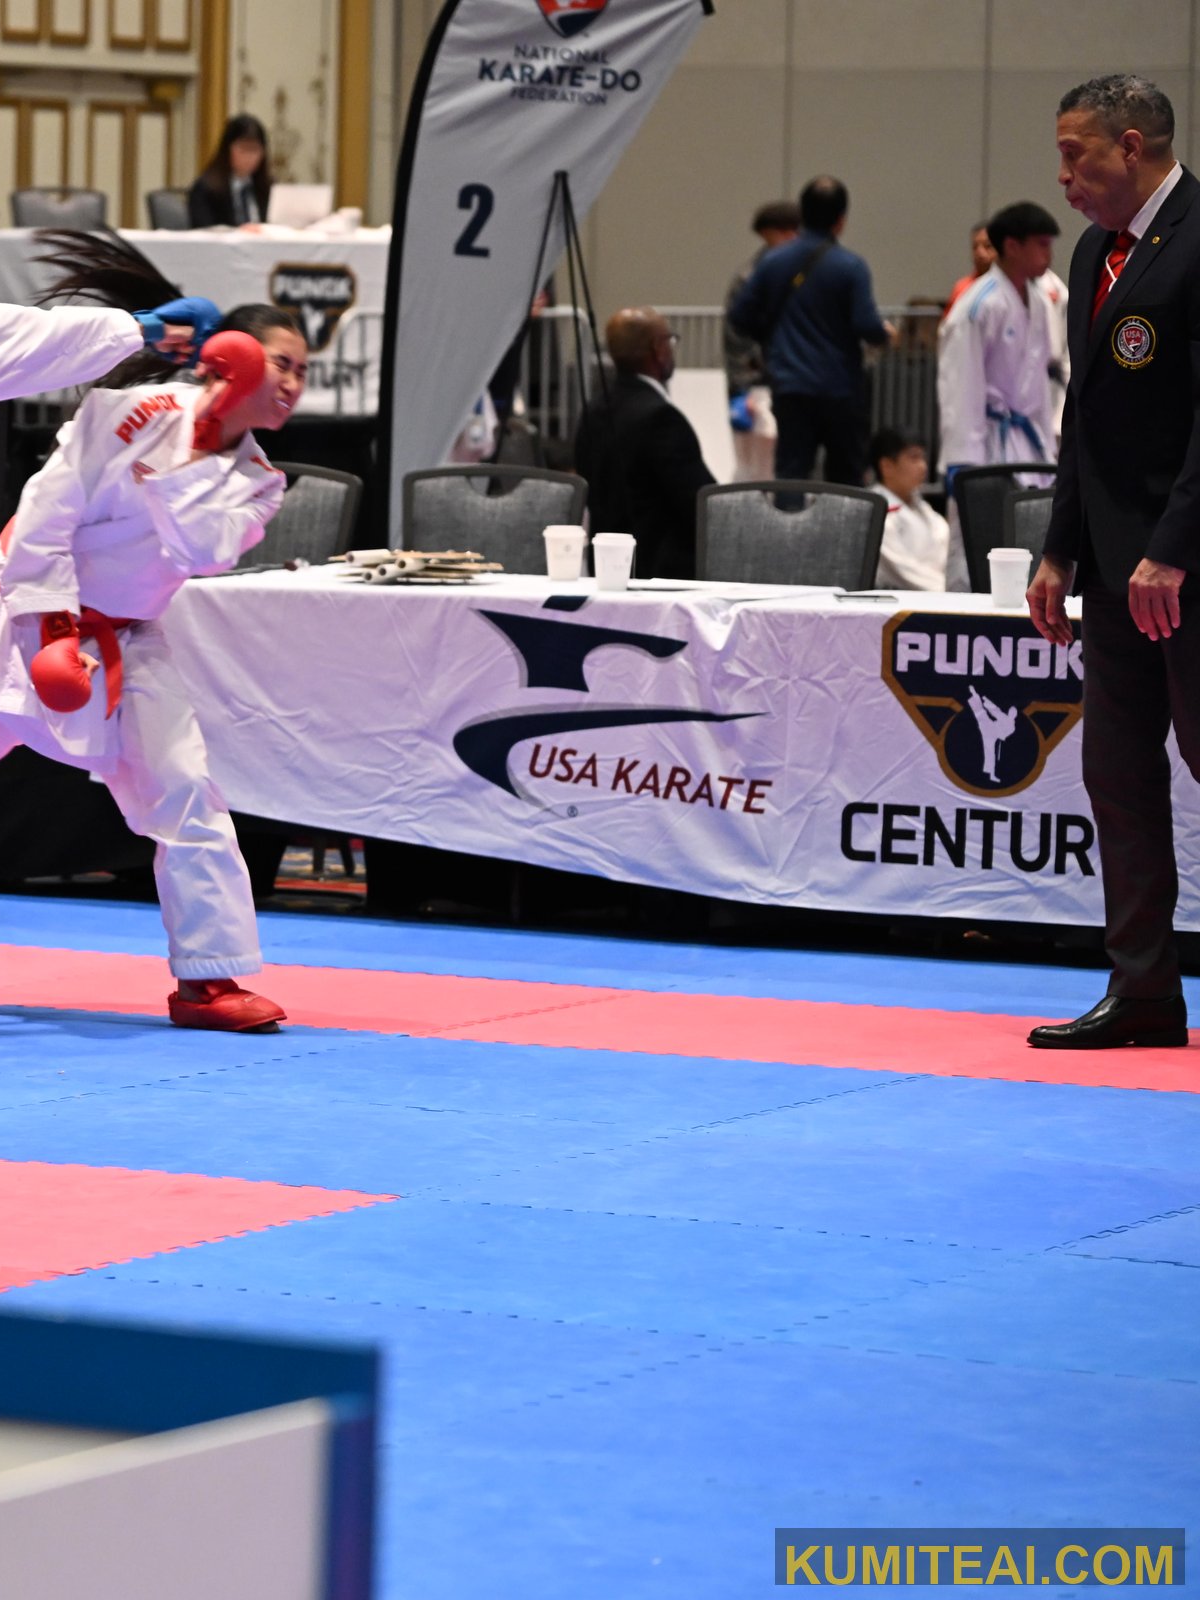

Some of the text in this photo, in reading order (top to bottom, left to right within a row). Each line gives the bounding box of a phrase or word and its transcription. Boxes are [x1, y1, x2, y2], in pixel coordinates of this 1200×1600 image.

[478, 58, 641, 92] KARATE-DO
[514, 45, 609, 64] NATIONAL
[510, 86, 608, 105] FEDERATION
[454, 183, 495, 258] 2
[896, 631, 1084, 680] PUNOK
[528, 744, 773, 814] USA KARATE
[841, 801, 1096, 876] CENTUR
